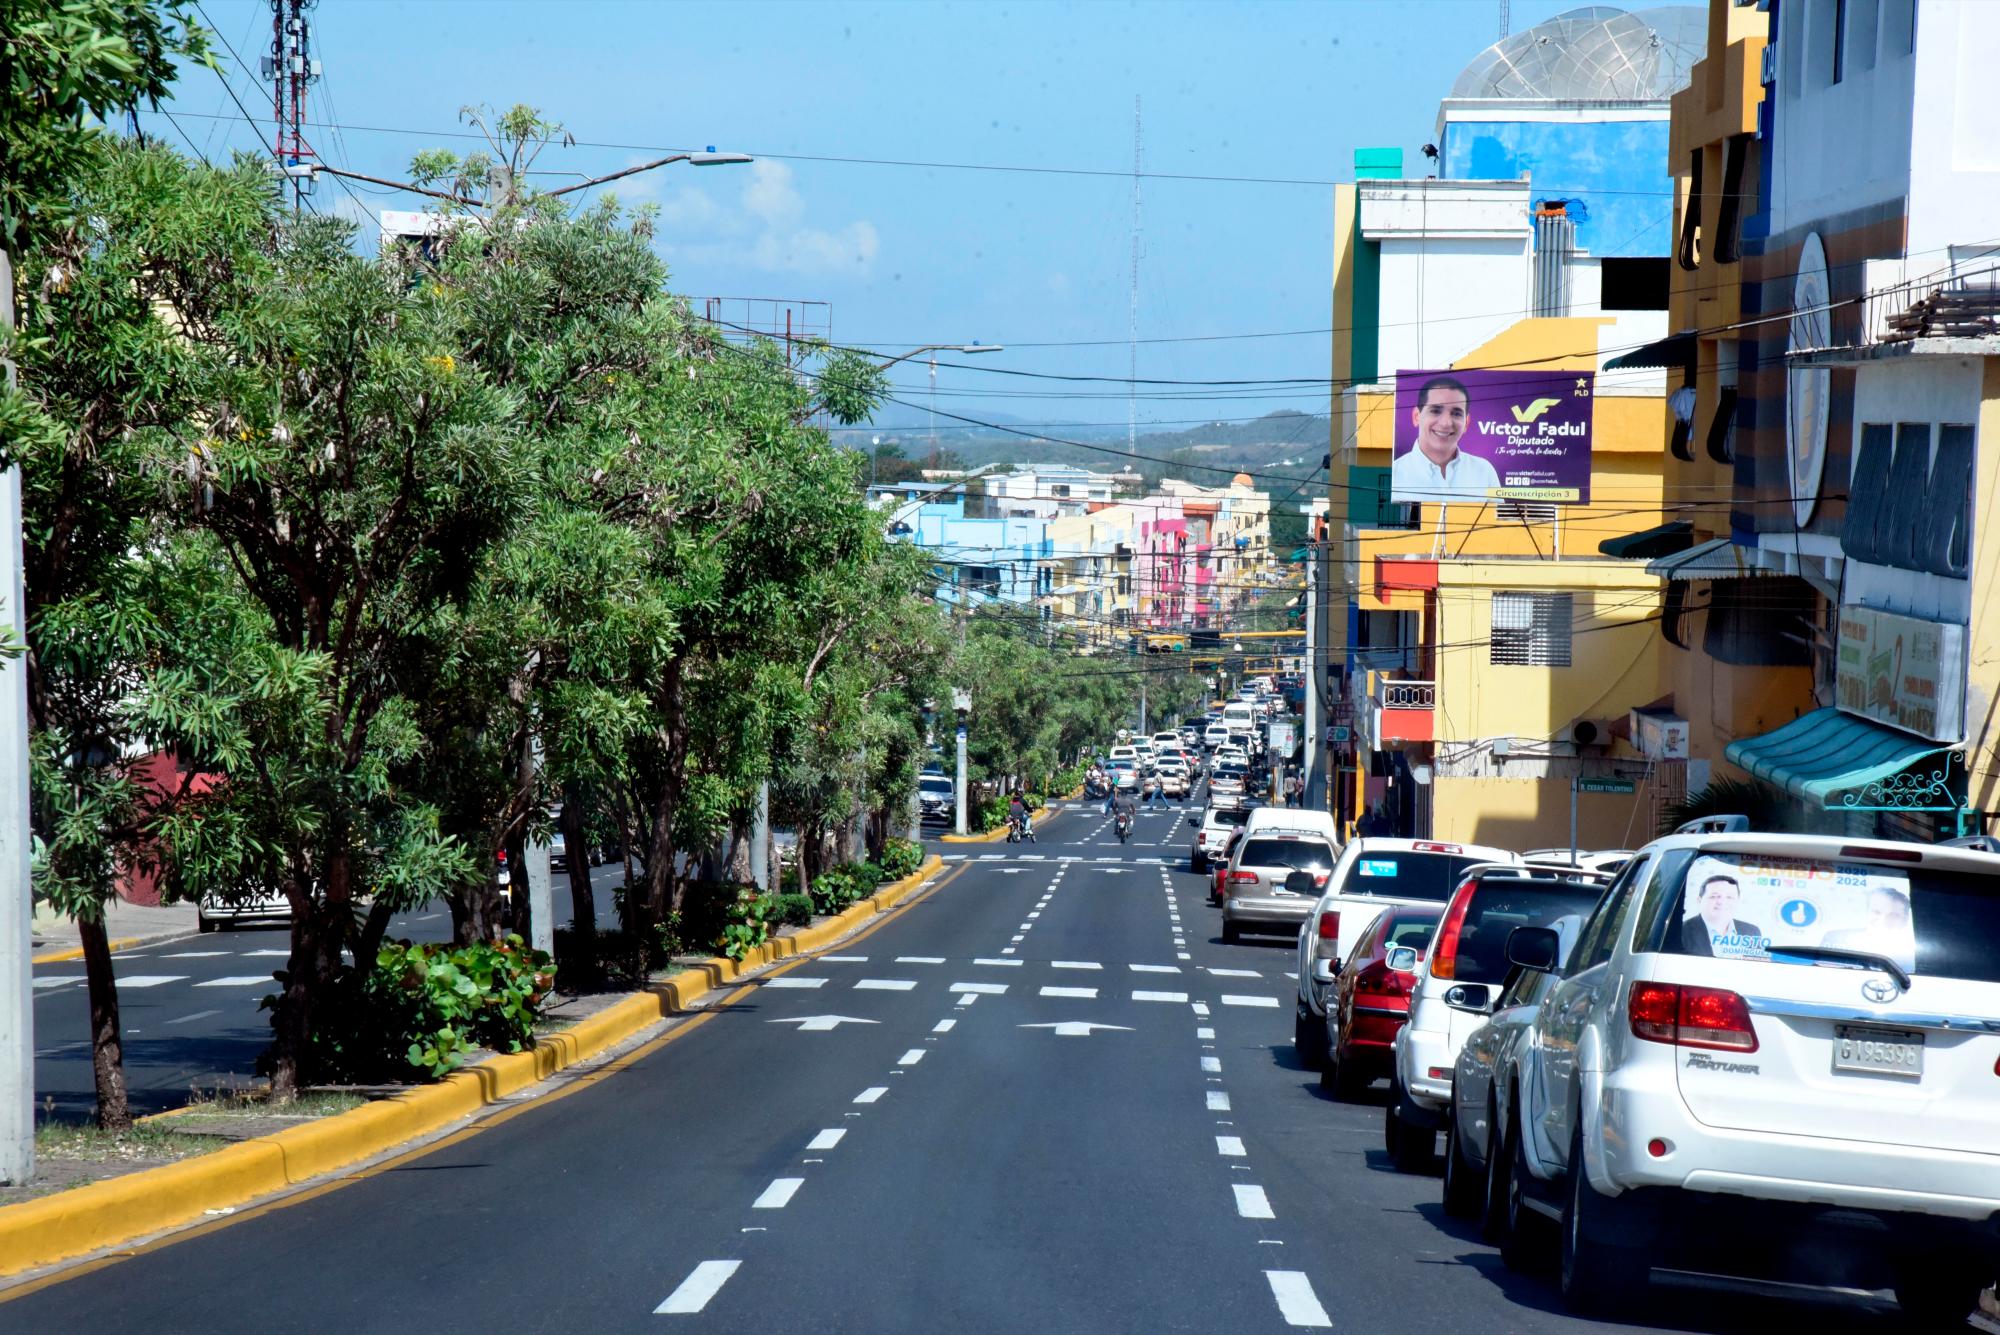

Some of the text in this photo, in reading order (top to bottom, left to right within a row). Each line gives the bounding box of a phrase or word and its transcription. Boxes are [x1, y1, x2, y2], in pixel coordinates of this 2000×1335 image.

[1574, 389, 1589, 397] PLD
[1478, 421, 1586, 436] Víctor Fadul
[1507, 435, 1555, 446] Diputado
[1495, 489, 1562, 499] Circunscripción
[1760, 856, 1815, 866] CANDIDATOS
[1739, 861, 1836, 881] CAMBIO
[1836, 876, 1868, 887] 2024
[1712, 934, 1772, 948] FAUSTO
[1686, 1058, 1760, 1076] FORTUNER
